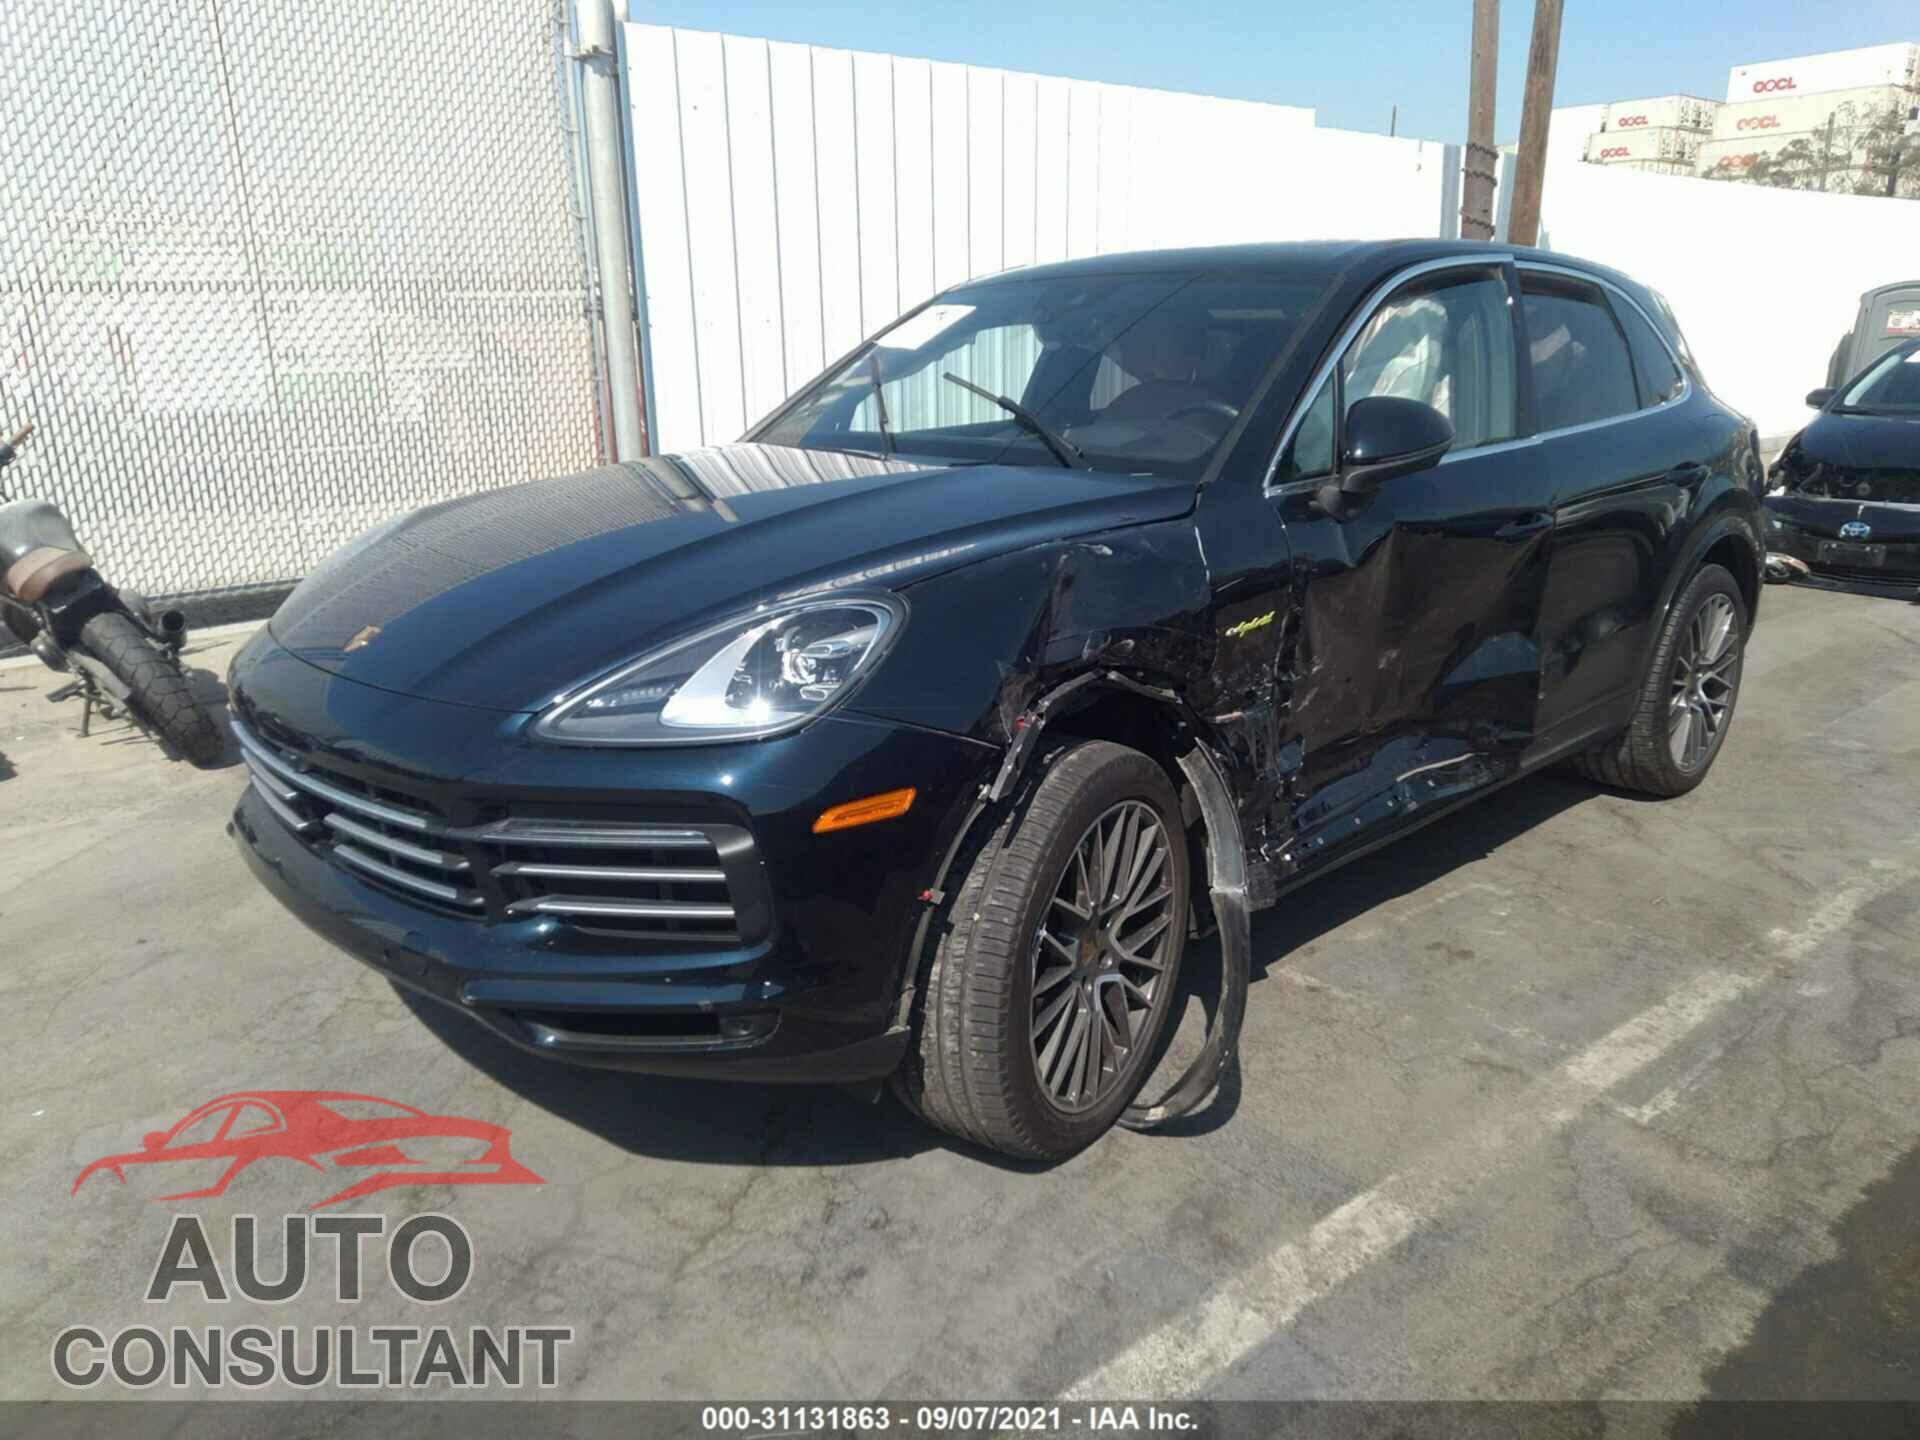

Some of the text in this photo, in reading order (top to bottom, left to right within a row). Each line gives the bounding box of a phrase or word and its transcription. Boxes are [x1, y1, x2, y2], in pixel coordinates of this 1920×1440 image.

[1753, 76, 1797, 93] OOCL
[1618, 115, 1648, 127] OOCL
[1736, 114, 1781, 130] OOCL
[1600, 147, 1630, 158] OOCL
